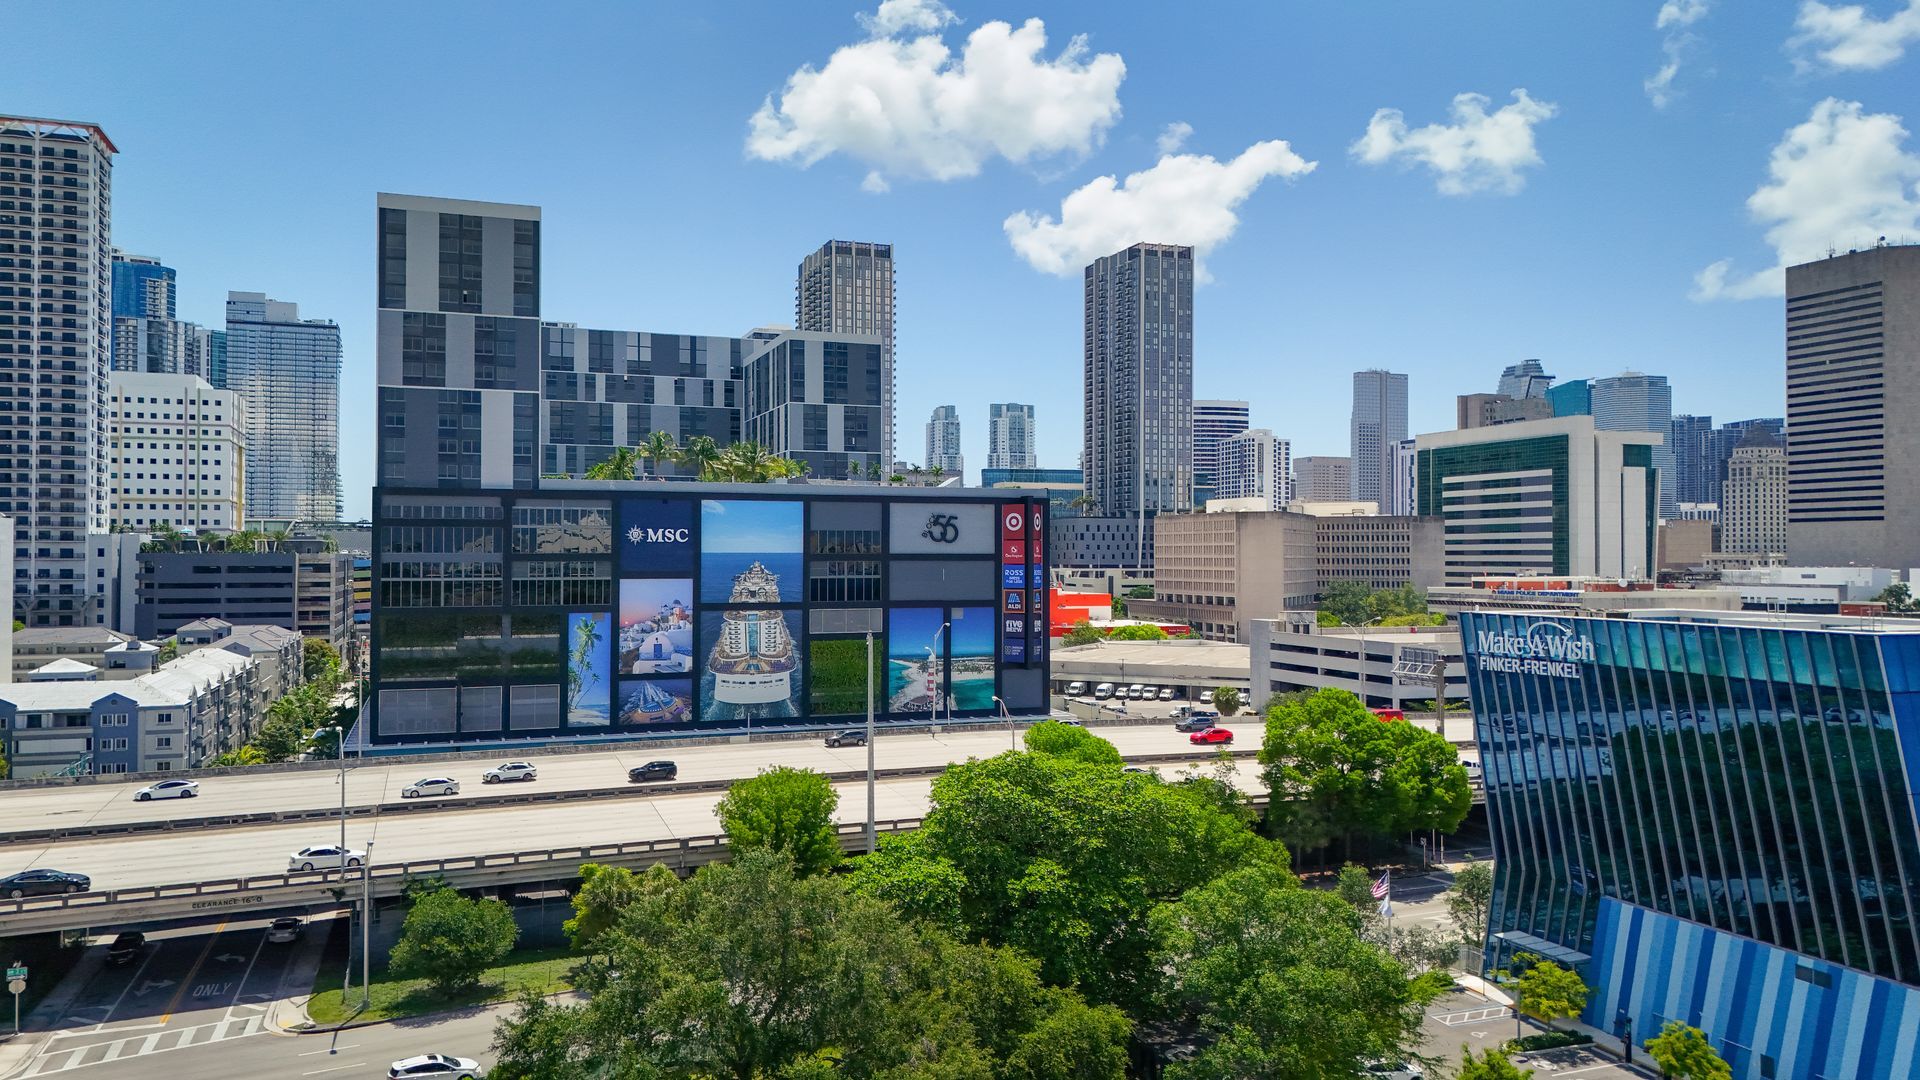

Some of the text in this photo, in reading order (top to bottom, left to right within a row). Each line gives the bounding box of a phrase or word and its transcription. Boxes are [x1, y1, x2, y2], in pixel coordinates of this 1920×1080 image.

[646, 528, 689, 543] MSC
[1480, 656, 1580, 679] FINKER-FRENKEL
[192, 897, 238, 909] CLEARANCE
[192, 982, 233, 997] ONLY
